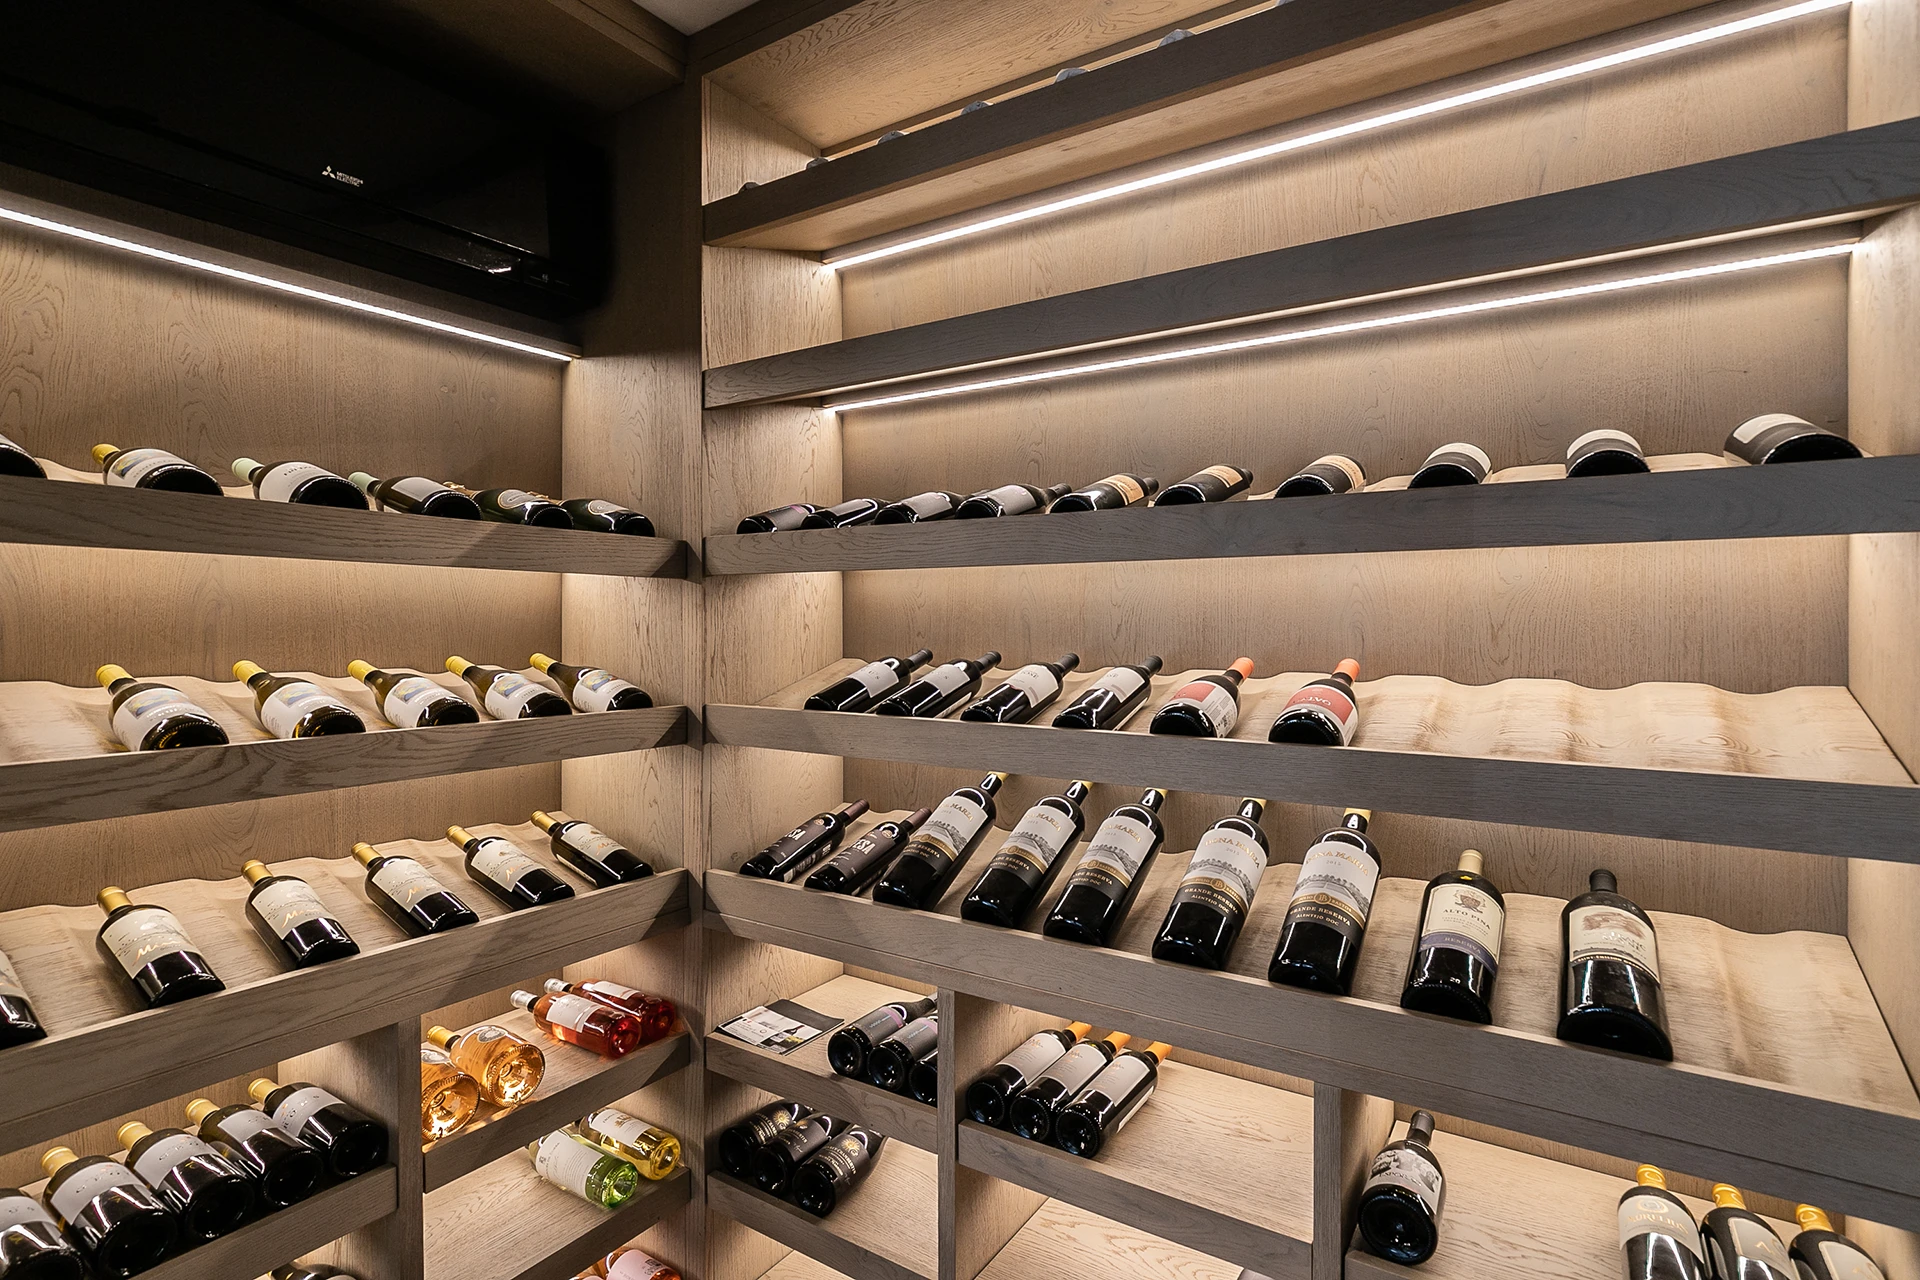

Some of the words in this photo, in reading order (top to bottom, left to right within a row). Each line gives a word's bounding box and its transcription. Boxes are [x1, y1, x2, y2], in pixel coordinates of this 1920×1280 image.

[1335, 850, 1369, 877] MARIA
[1085, 870, 1113, 886] RESERVA
[1184, 887, 1212, 896] GRANDE
[1212, 890, 1238, 915] RESERVA
[1288, 906, 1317, 916] GRANDE
[1317, 907, 1352, 927] RESERVA
[1295, 913, 1325, 921] ALENTEJO
[1325, 917, 1340, 926] DOC
[1443, 908, 1468, 917] ALTO
[1471, 913, 1491, 930] PINA
[1444, 937, 1481, 954] RESERVA
